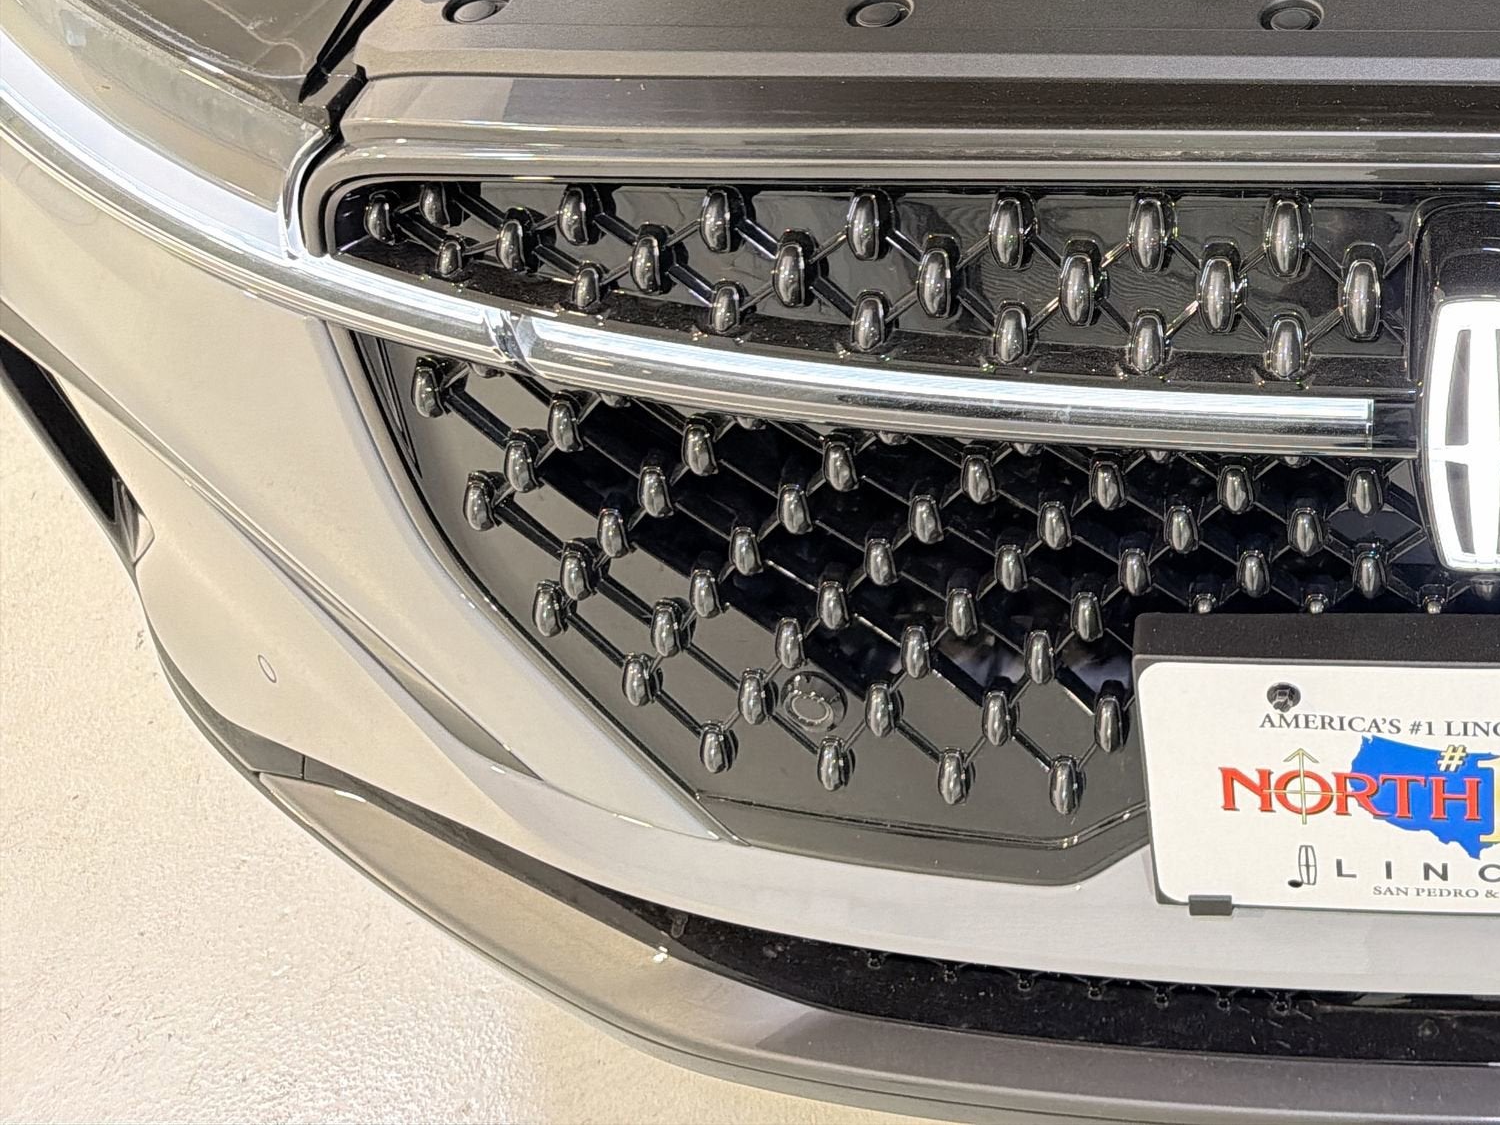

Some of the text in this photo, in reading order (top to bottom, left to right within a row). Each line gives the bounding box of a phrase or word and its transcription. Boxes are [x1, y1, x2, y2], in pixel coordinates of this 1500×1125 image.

[1259, 713, 1402, 735] AMERICA'S
[1408, 720, 1434, 736] #1
[1218, 767, 1483, 821] NORTH
[1373, 885, 1409, 896] SAN
[1414, 886, 1479, 899] PEDRO
[1485, 888, 1500, 899] &
